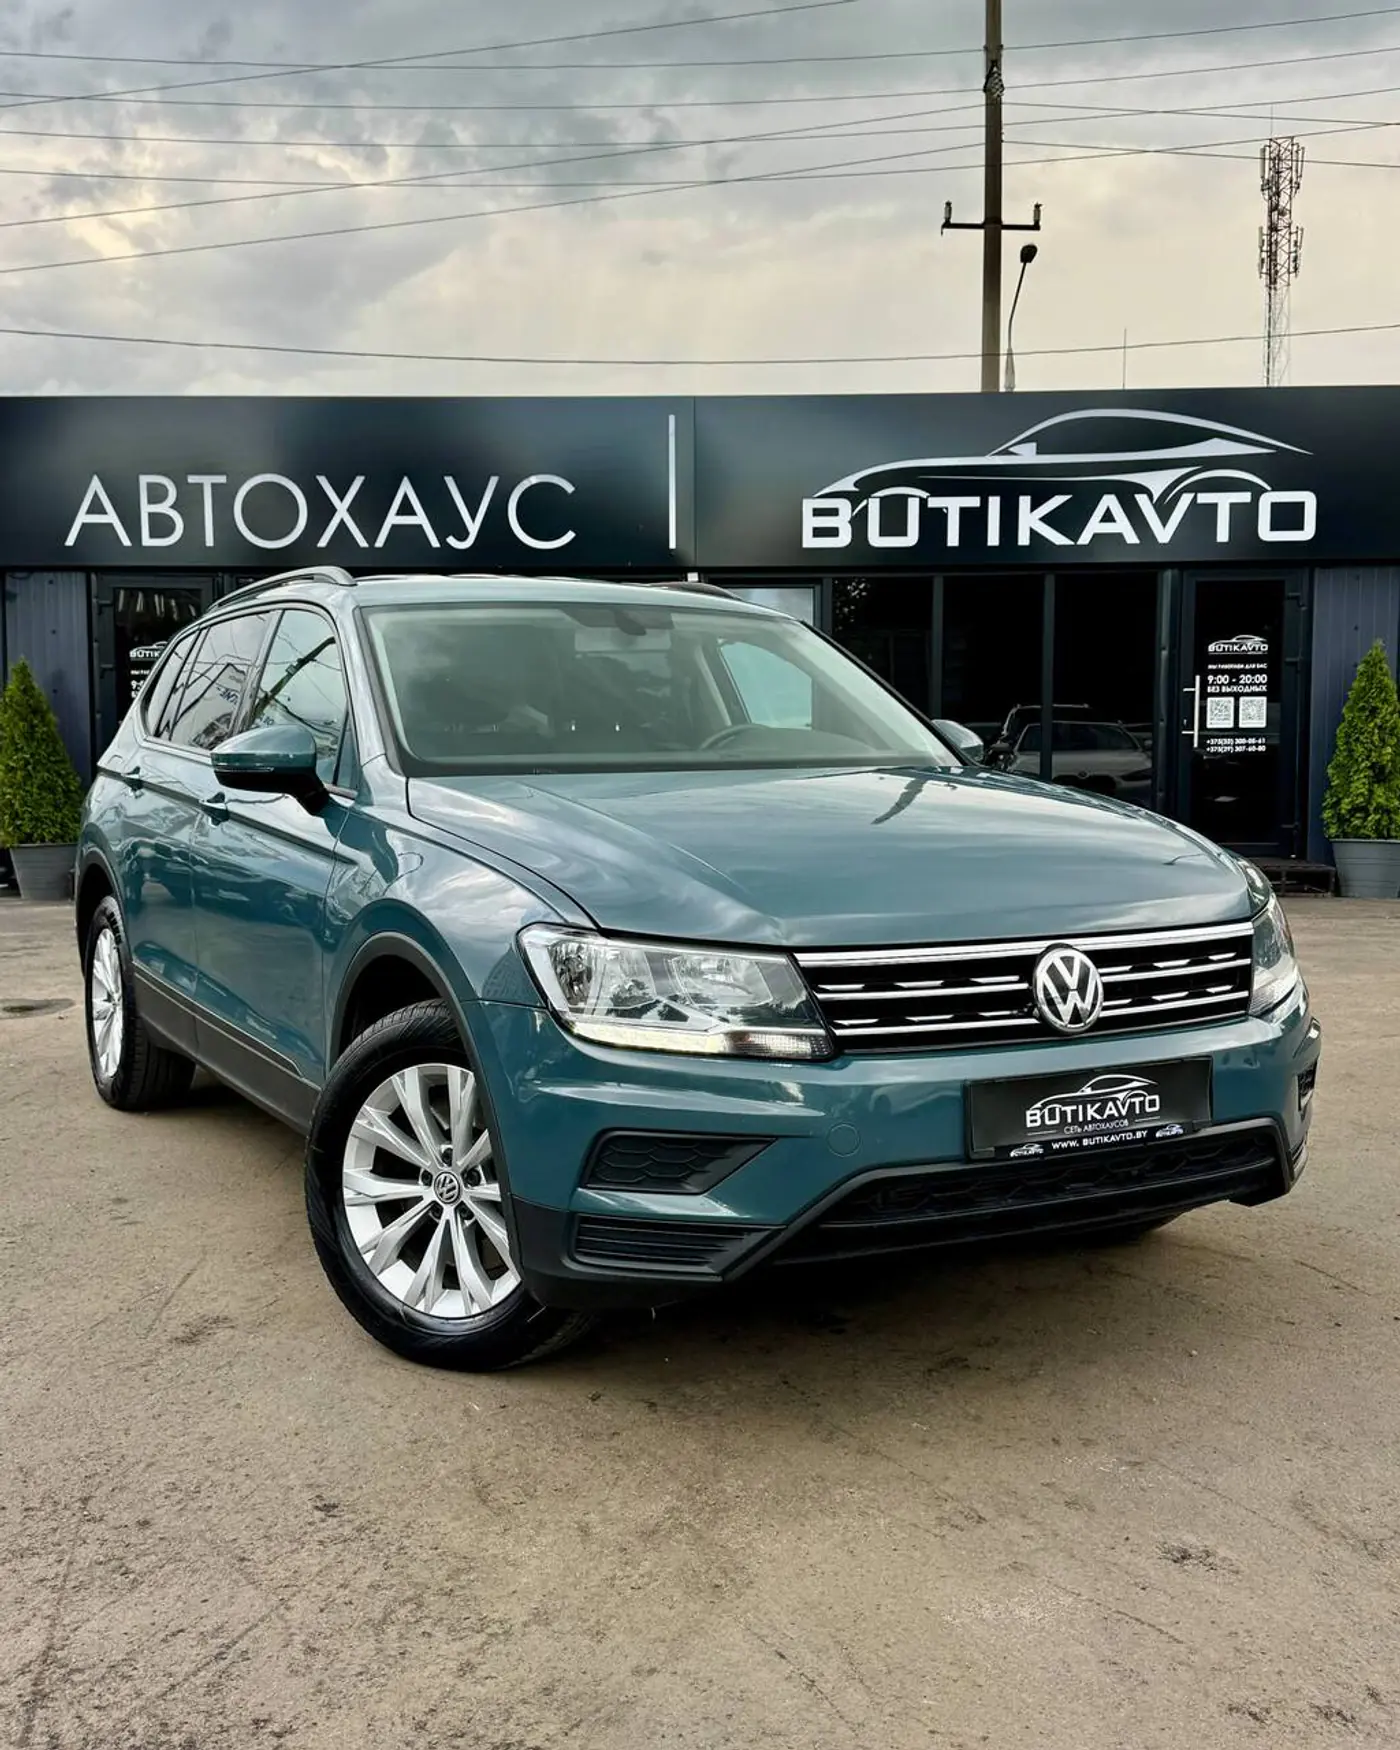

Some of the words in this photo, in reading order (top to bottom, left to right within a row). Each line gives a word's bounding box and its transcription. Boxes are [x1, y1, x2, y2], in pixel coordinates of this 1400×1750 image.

[64, 473, 577, 550] АВТОХАУС
[801, 490, 1317, 549] BUTIKAVTO
[129, 650, 161, 658] BUTIK
[1207, 643, 1269, 652] BUTIKAVTO
[1207, 675, 1229, 685] 9:00
[1239, 674, 1268, 684] 20:00
[1207, 685, 1220, 693] БЕЗ
[1221, 685, 1267, 693] ВЫХОДНЫХ
[1026, 1094, 1161, 1128] BUTIKAVTO
[1083, 1119, 1129, 1132] АВТОХАУСОВ
[1052, 1140, 1080, 1150] WWW.
[1082, 1130, 1149, 1147] BUTIKAVTO.BY
